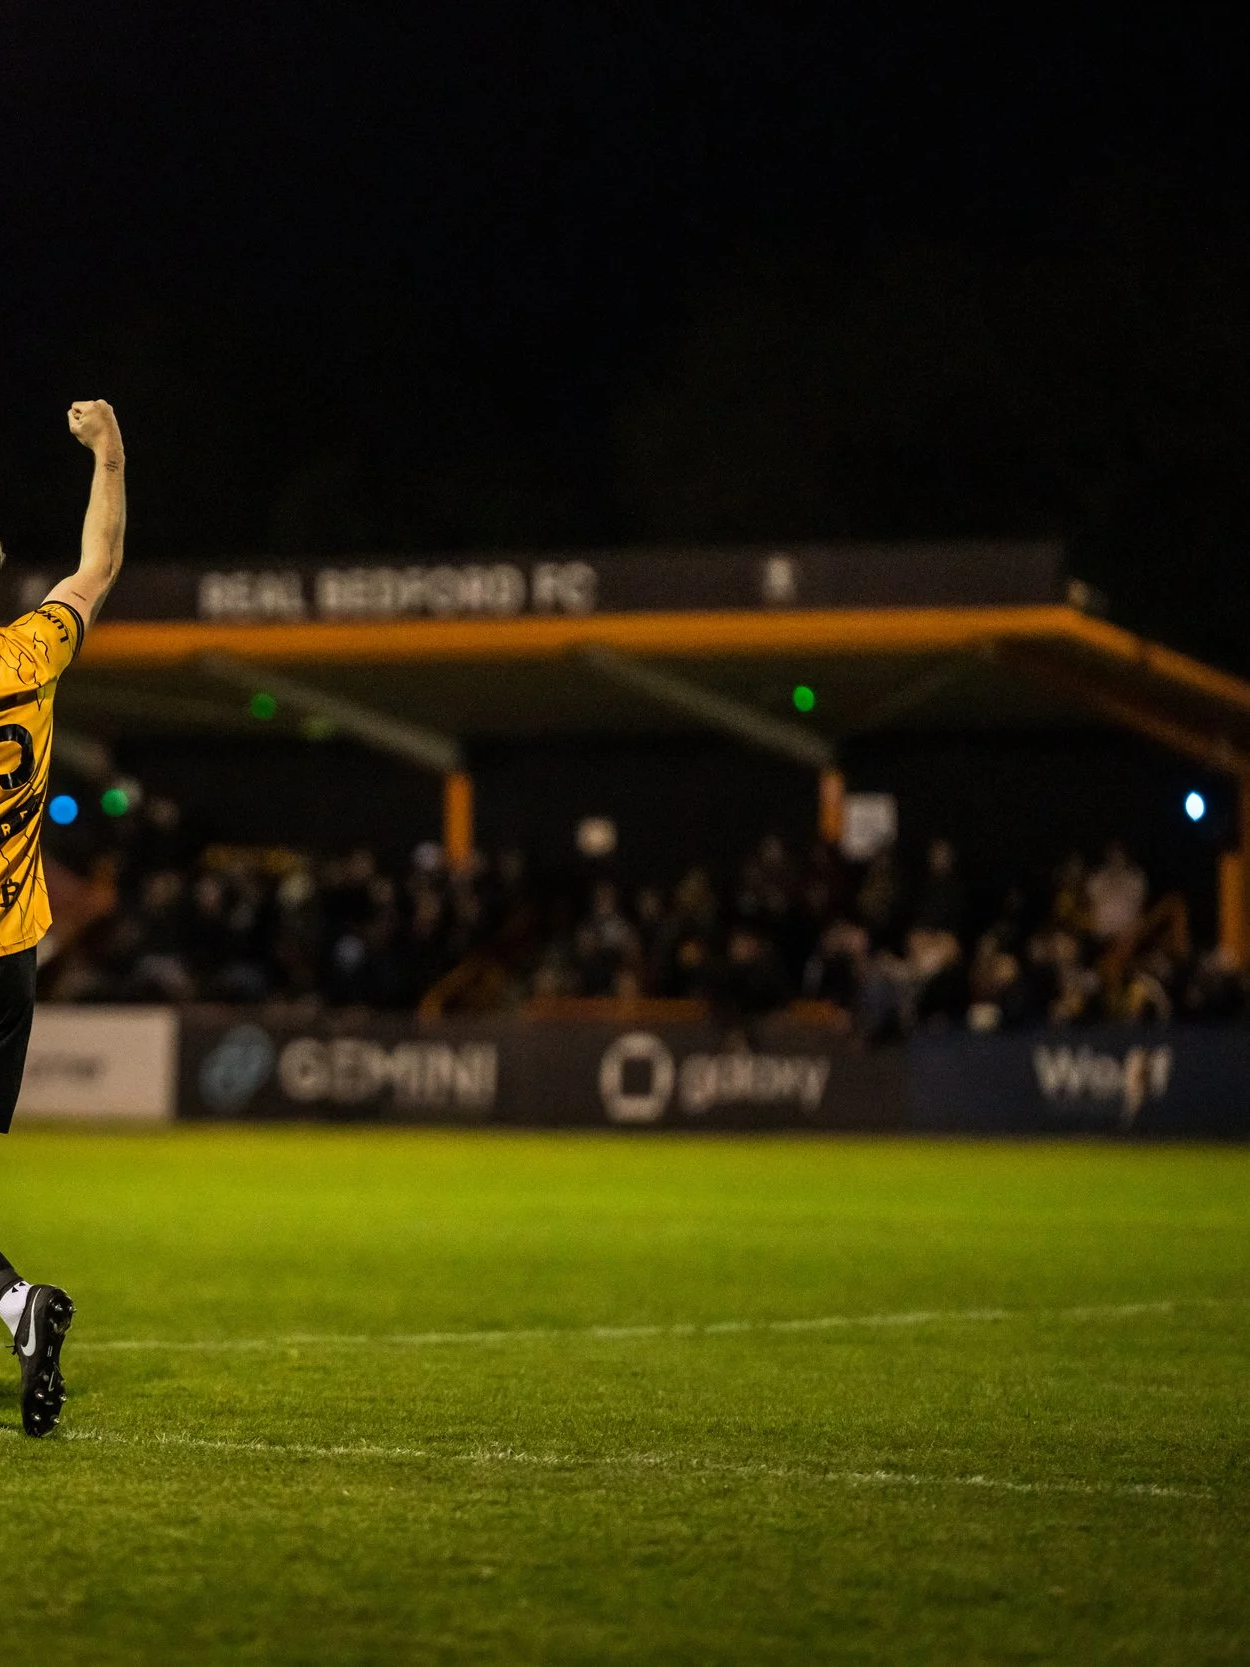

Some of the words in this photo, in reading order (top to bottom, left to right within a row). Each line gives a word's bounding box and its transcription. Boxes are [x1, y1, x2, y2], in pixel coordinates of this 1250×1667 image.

[199, 570, 304, 617] REAL
[314, 566, 526, 615] BEDFORD
[533, 560, 597, 612] FC
[277, 1037, 498, 1105] GEMINI
